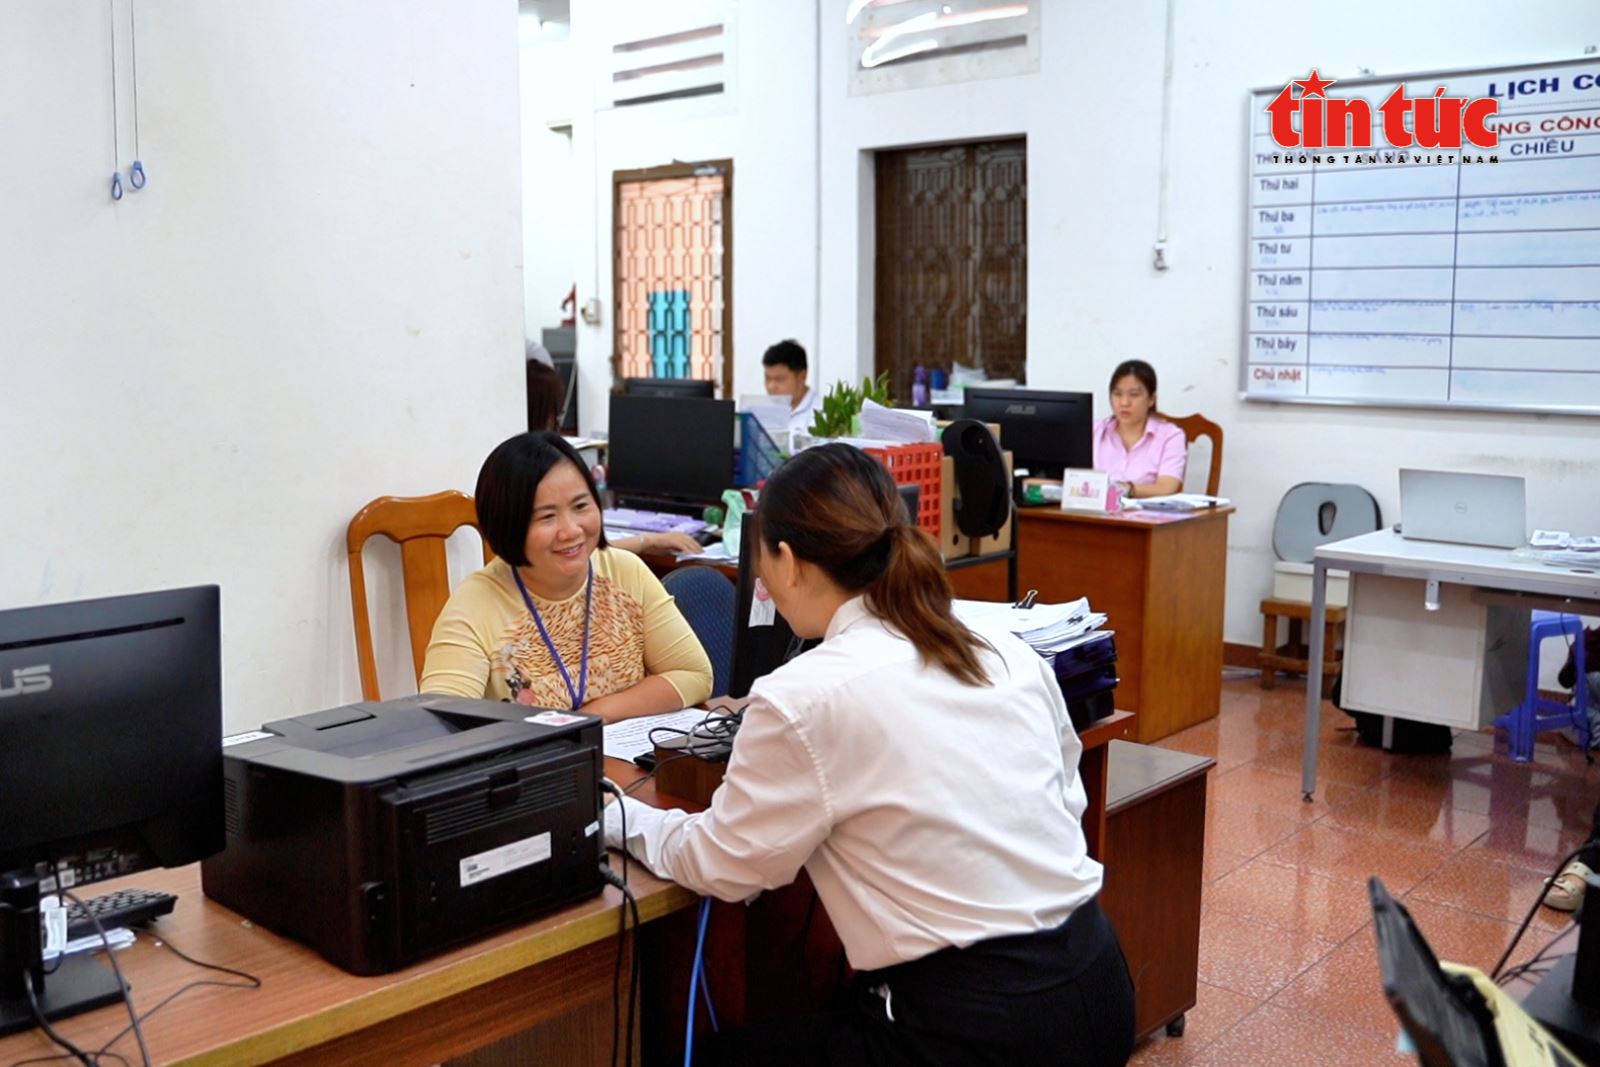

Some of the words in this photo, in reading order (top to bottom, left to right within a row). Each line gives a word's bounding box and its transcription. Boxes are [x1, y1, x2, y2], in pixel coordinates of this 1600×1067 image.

[1489, 77, 1560, 100] LỊCH
[1282, 177, 1299, 190] hai
[1281, 210, 1295, 223] ba
[1278, 305, 1299, 318] sáu
[1277, 368, 1302, 383] nhật
